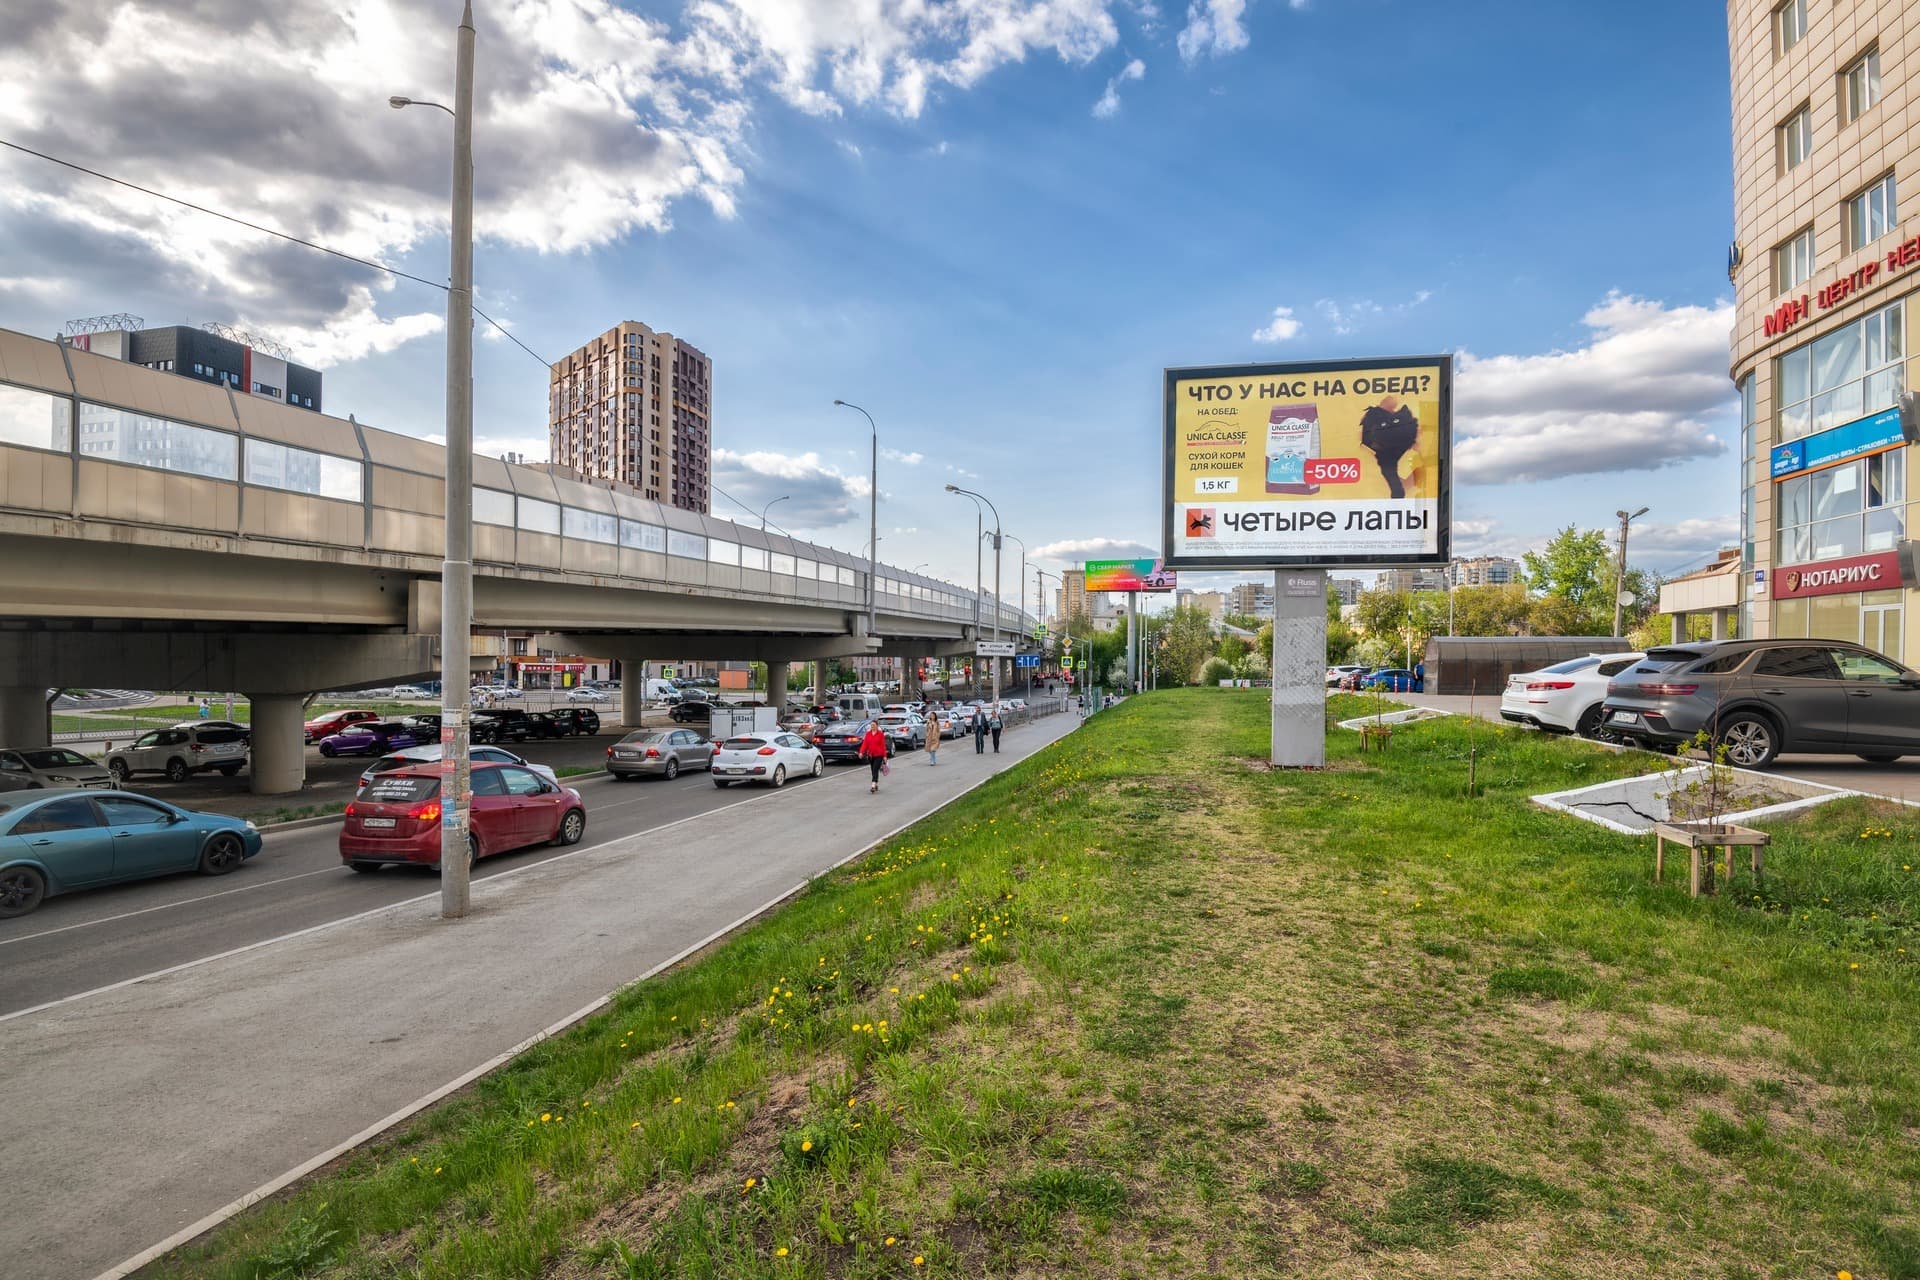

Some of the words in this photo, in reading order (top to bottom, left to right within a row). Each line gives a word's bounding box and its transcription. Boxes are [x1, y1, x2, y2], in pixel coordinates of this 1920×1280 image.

[1817, 261, 1880, 309] ЦЕНТР
[1188, 384, 1233, 402] ЧТО
[1239, 383, 1253, 400] У
[1259, 381, 1306, 399] НАС
[1313, 379, 1346, 396] НА
[1352, 375, 1431, 396] ОБЕД?
[1197, 408, 1210, 416] НА
[1211, 407, 1239, 415] ОБЕД:
[1291, 423, 1310, 431] CLASSE
[1186, 432, 1213, 441] UNICA
[1216, 431, 1247, 440] CLASSE
[1188, 452, 1218, 460] СУХОЙ
[1190, 463, 1209, 471] ДЛЯ
[1211, 462, 1243, 470] КОШЕК
[1305, 463, 1358, 479] -50%
[1202, 480, 1215, 491] 1,5
[1217, 481, 1231, 489] КГ
[1223, 510, 1337, 532] четыре
[1344, 509, 1428, 531] лапы
[1801, 563, 1881, 588] НОТАРИУС
